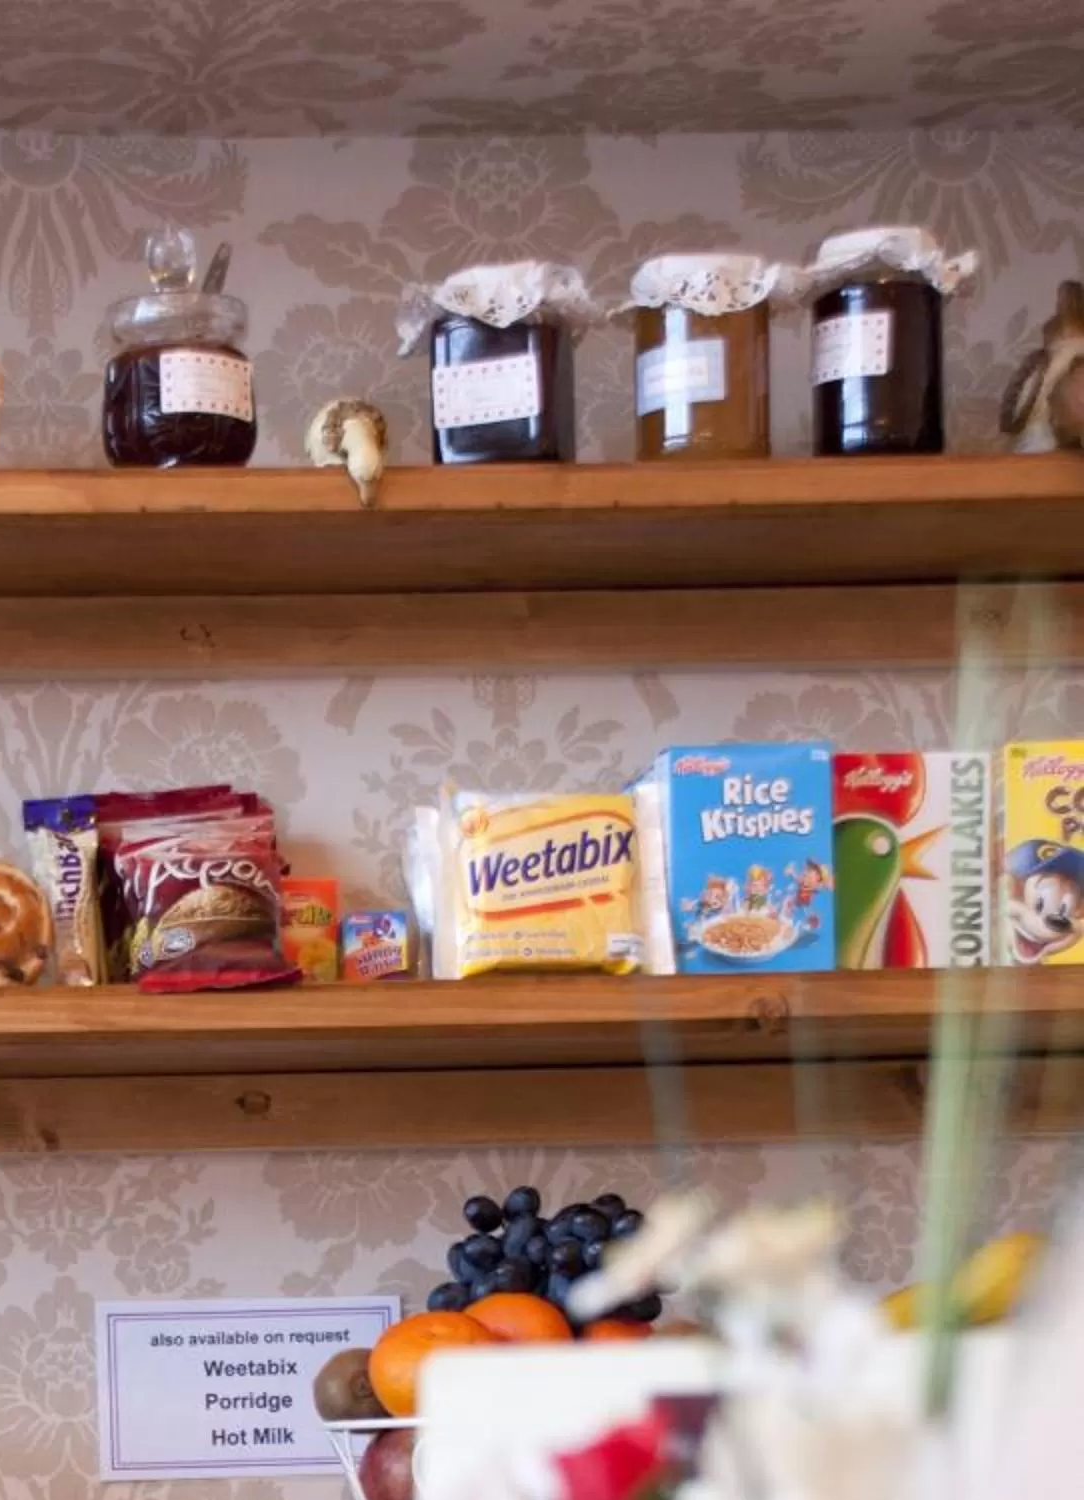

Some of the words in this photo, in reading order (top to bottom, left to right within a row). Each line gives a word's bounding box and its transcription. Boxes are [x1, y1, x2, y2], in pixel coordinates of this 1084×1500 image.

[723, 773, 790, 805] Rice
[700, 805, 814, 842] Krispies
[951, 758, 986, 877] FLAKES
[468, 824, 635, 896] Weetabix
[149, 1333, 184, 1347] also
[188, 1330, 259, 1345] available
[263, 1333, 284, 1345] on
[288, 1328, 351, 1345] request
[203, 1359, 298, 1377] Weetabix
[204, 1392, 293, 1412] Porridge
[211, 1429, 247, 1446] Hot
[253, 1427, 295, 1445] Milk
